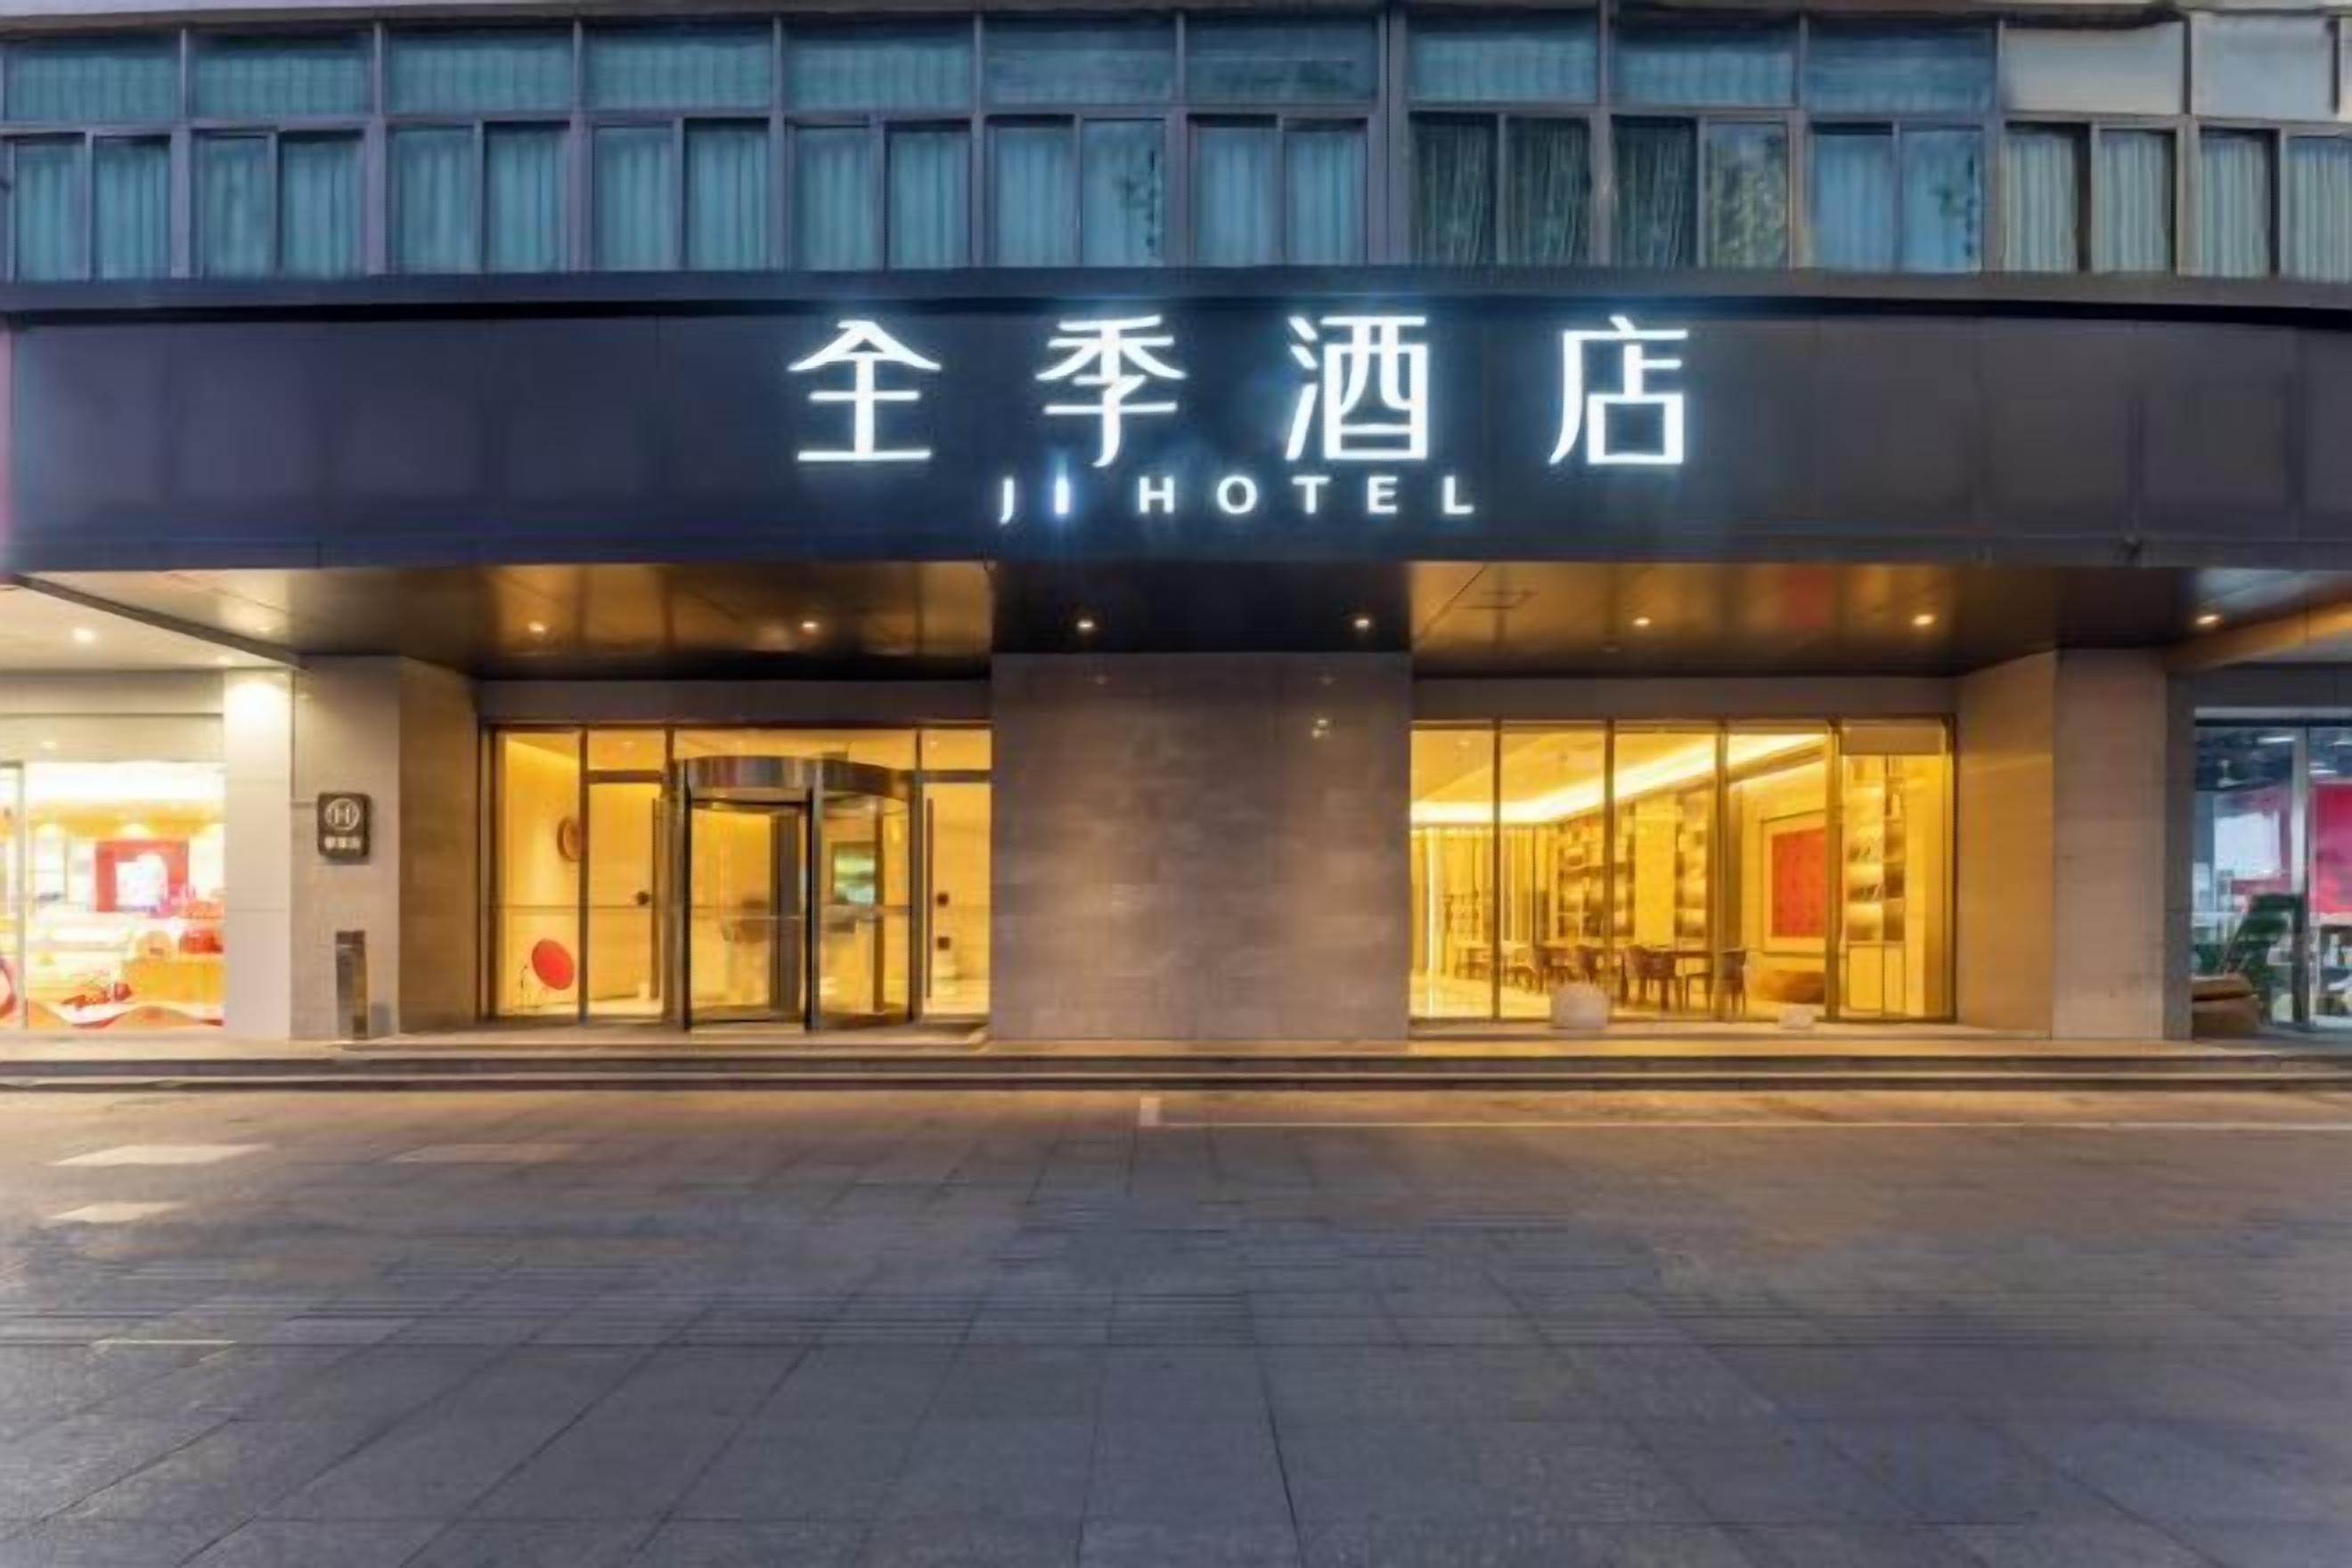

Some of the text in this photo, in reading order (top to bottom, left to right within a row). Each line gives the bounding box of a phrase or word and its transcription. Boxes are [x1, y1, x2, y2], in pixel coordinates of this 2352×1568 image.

[788, 314, 1689, 469] 全季酒店
[999, 473, 1474, 524] JI HOTEL
